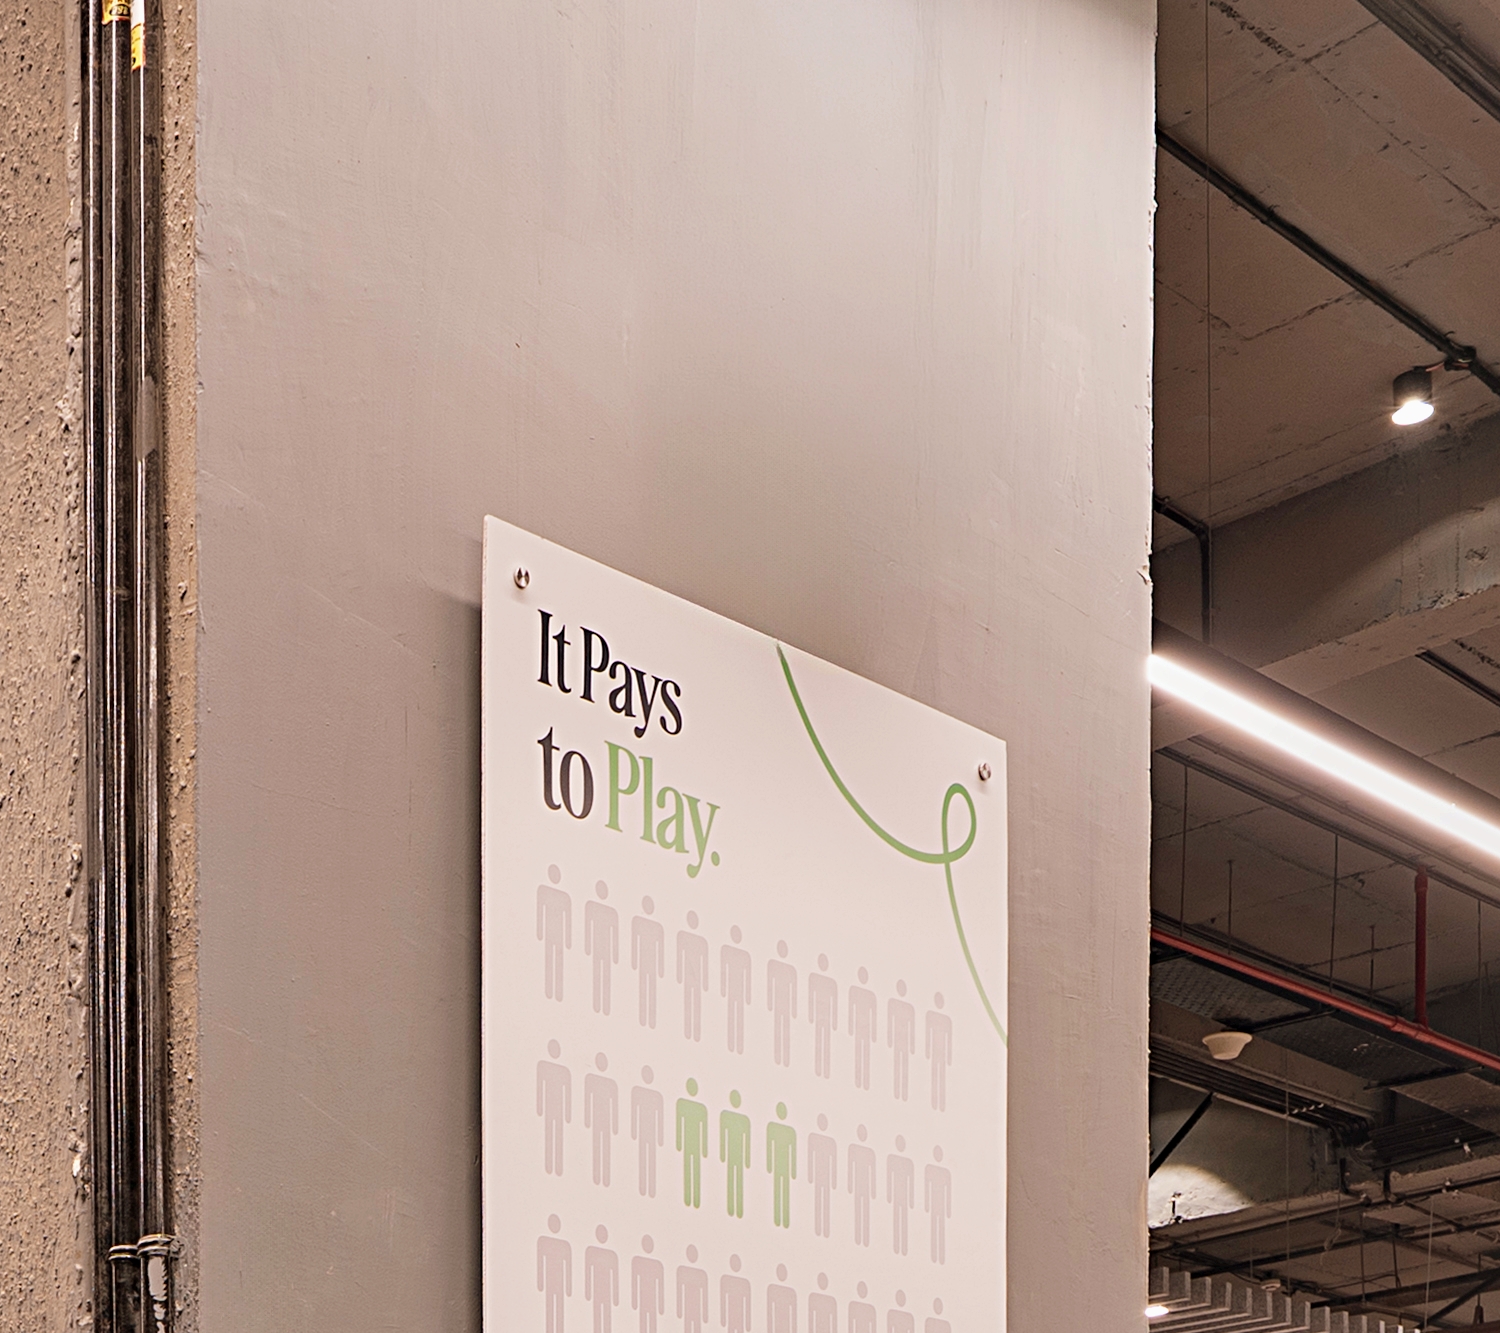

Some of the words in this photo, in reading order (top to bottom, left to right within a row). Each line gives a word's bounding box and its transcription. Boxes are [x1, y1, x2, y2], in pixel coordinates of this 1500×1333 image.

[537, 609, 572, 694] It
[579, 626, 682, 738] Pays
[537, 726, 594, 819] to
[605, 740, 721, 879] Play.
